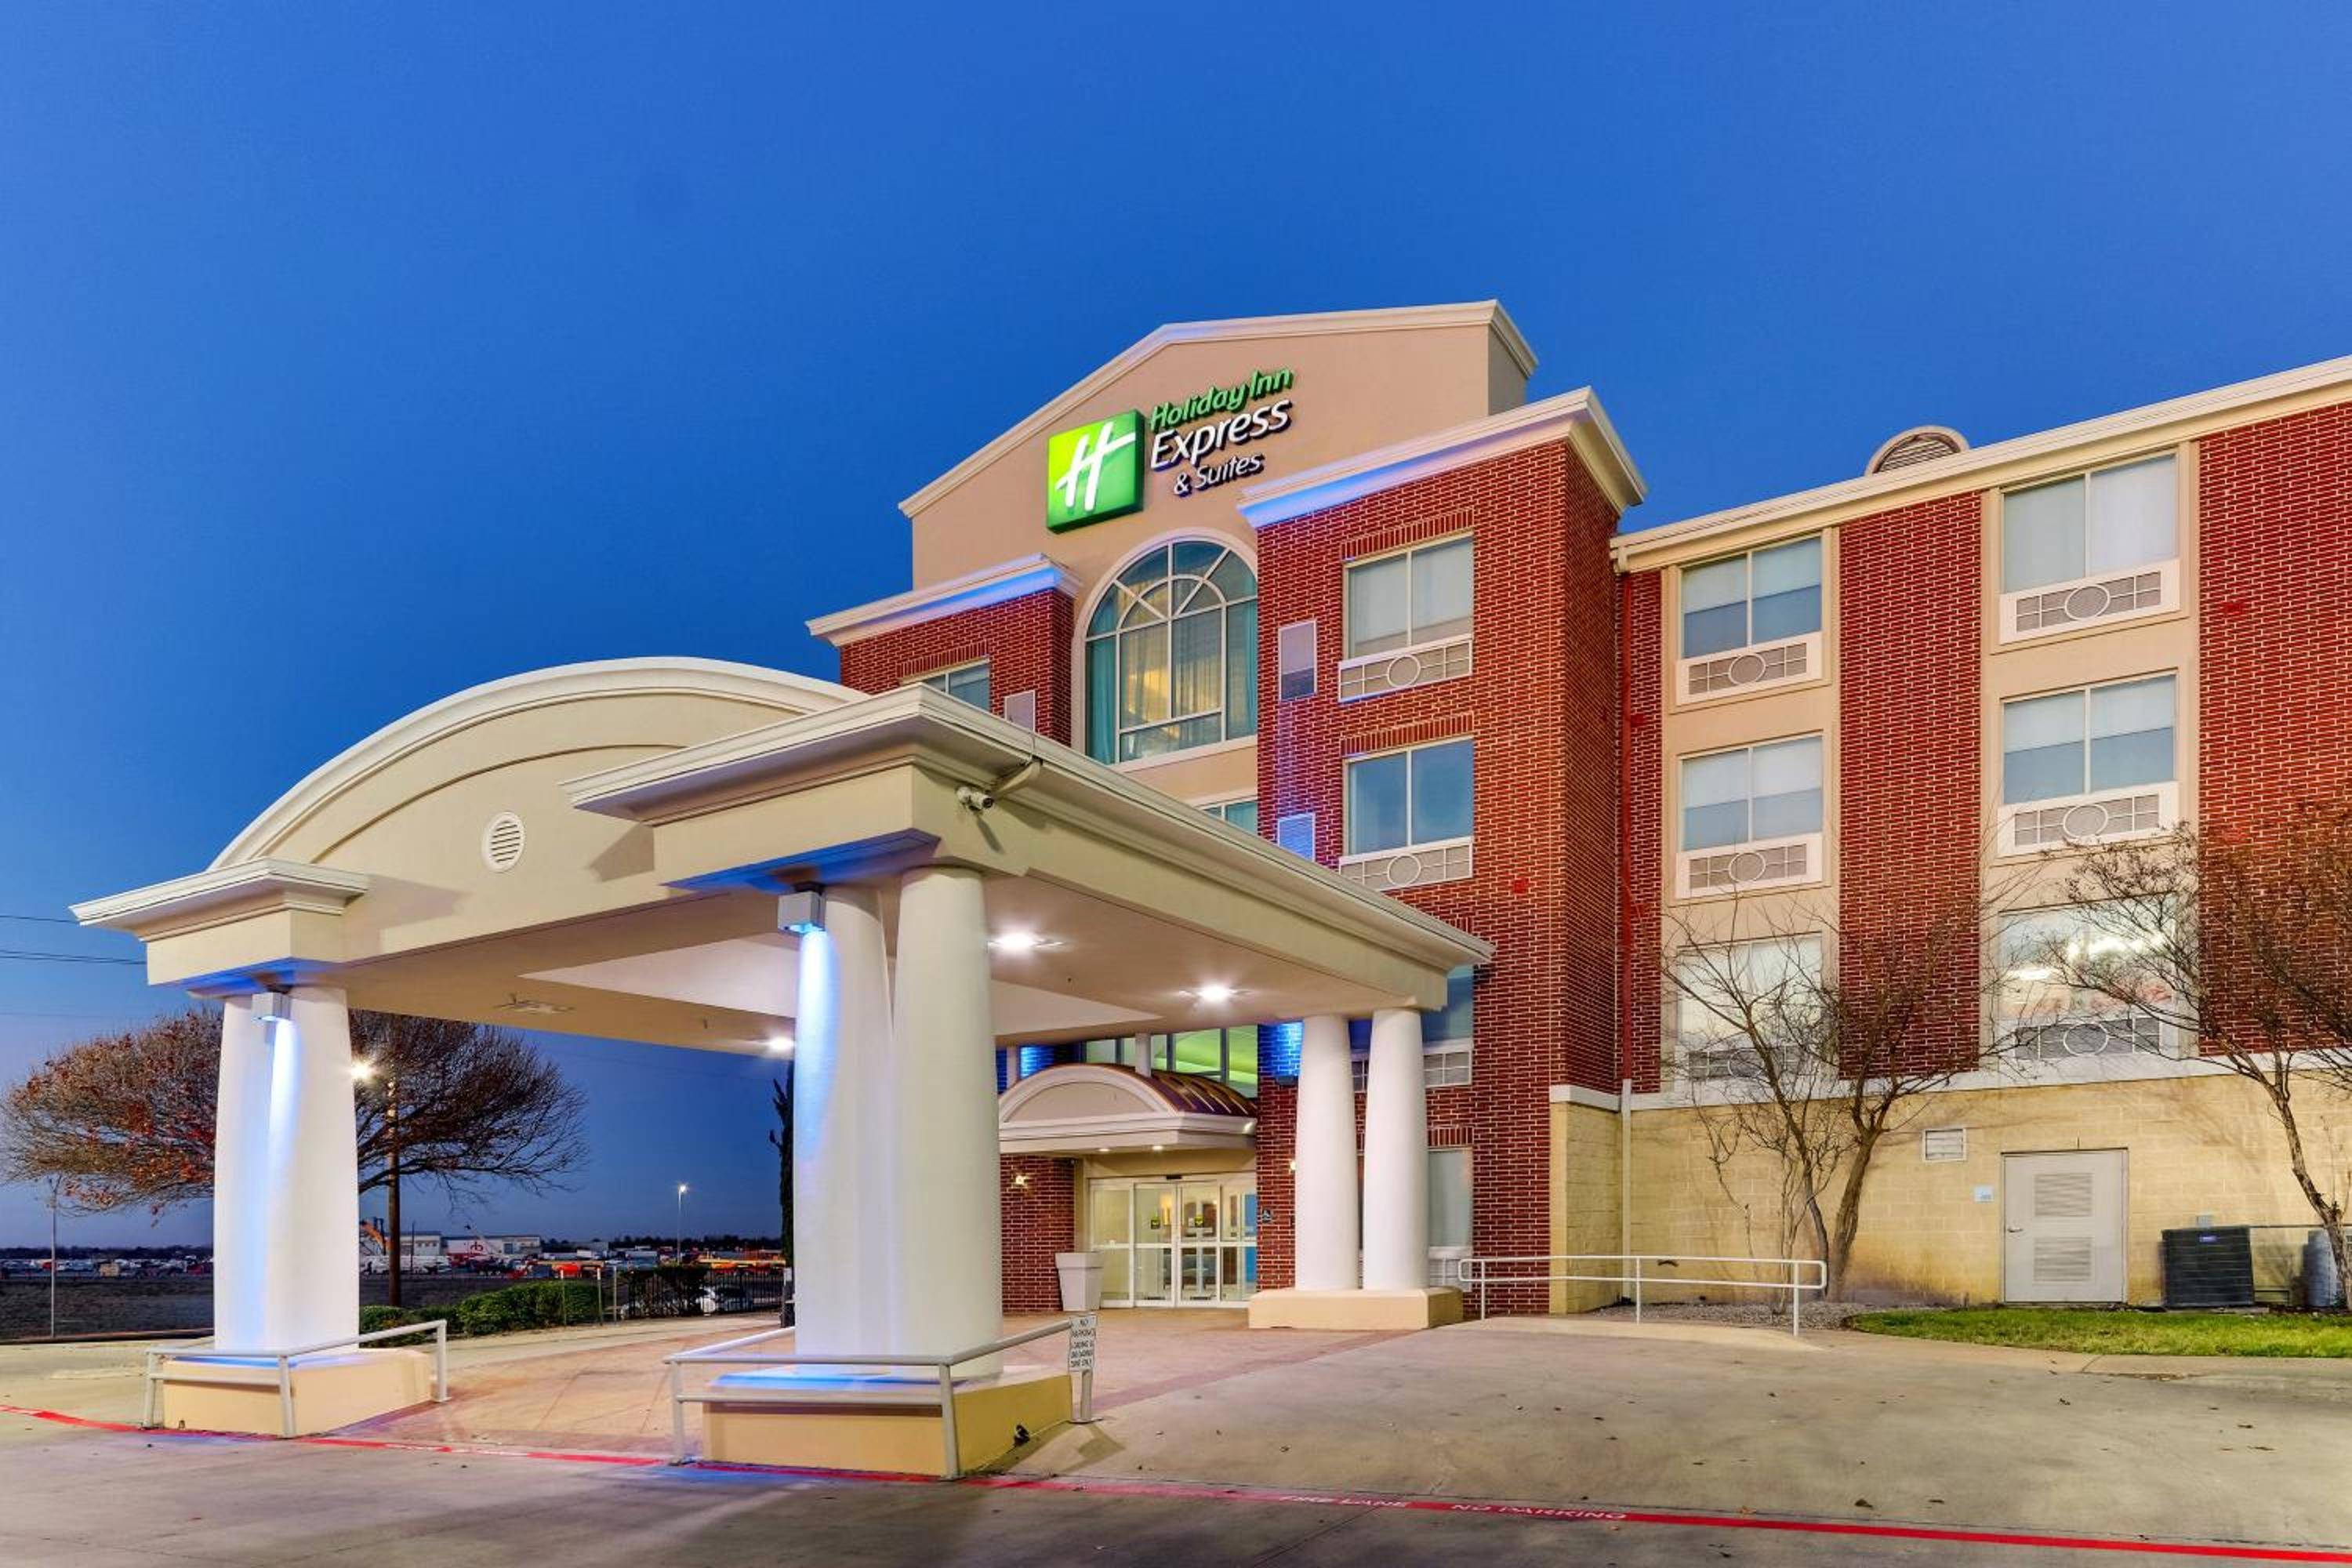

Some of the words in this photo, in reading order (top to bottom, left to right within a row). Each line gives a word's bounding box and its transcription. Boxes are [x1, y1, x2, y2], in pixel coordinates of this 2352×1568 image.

[1150, 383, 1248, 432] Holiday
[1249, 368, 1294, 399] Inn
[1150, 399, 1293, 472] Express
[1174, 472, 1192, 497] &
[1194, 453, 1265, 491] Suites
[1498, 1506, 1627, 1519] PARKING
